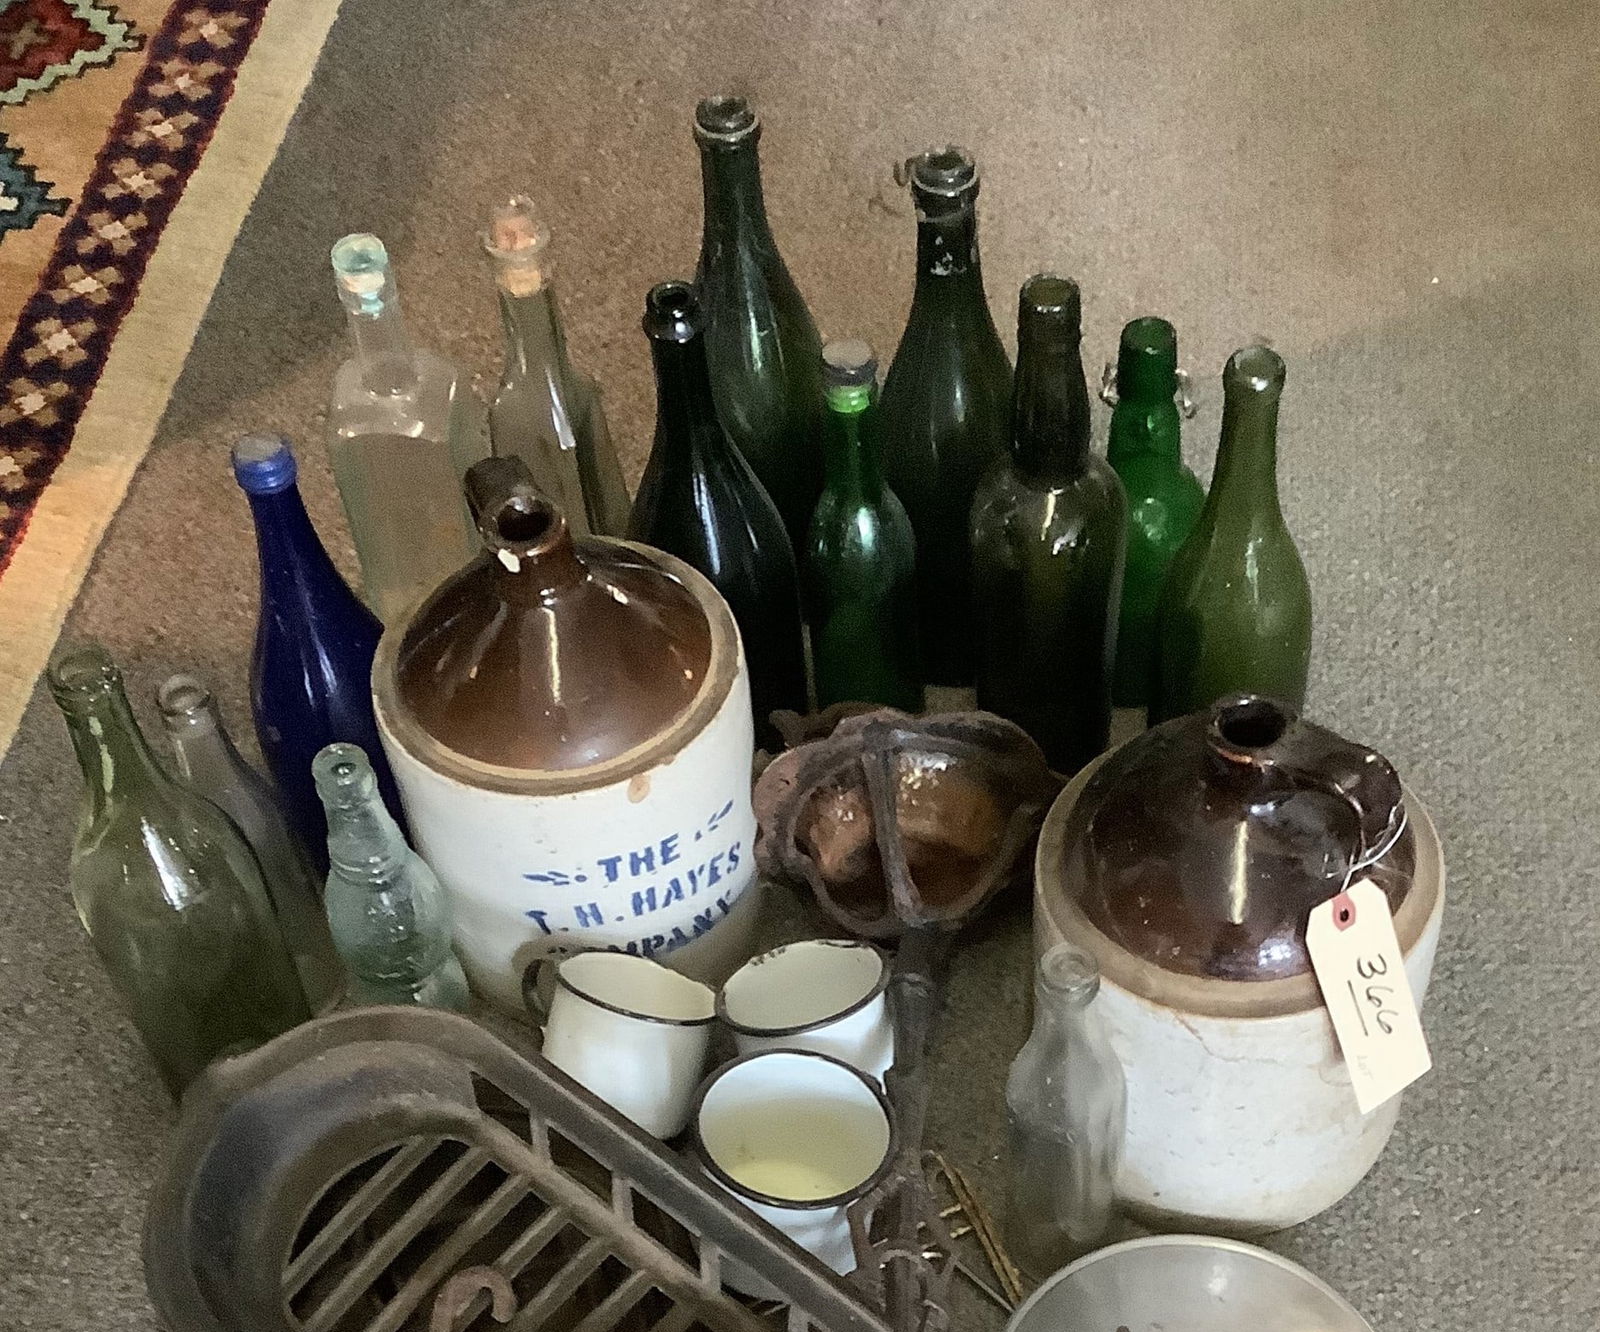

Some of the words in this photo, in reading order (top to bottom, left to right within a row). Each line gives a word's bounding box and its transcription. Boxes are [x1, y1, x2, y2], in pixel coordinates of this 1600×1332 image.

[597, 832, 681, 883] THE
[631, 841, 741, 917] HAYES
[1356, 953, 1399, 1035] 366
